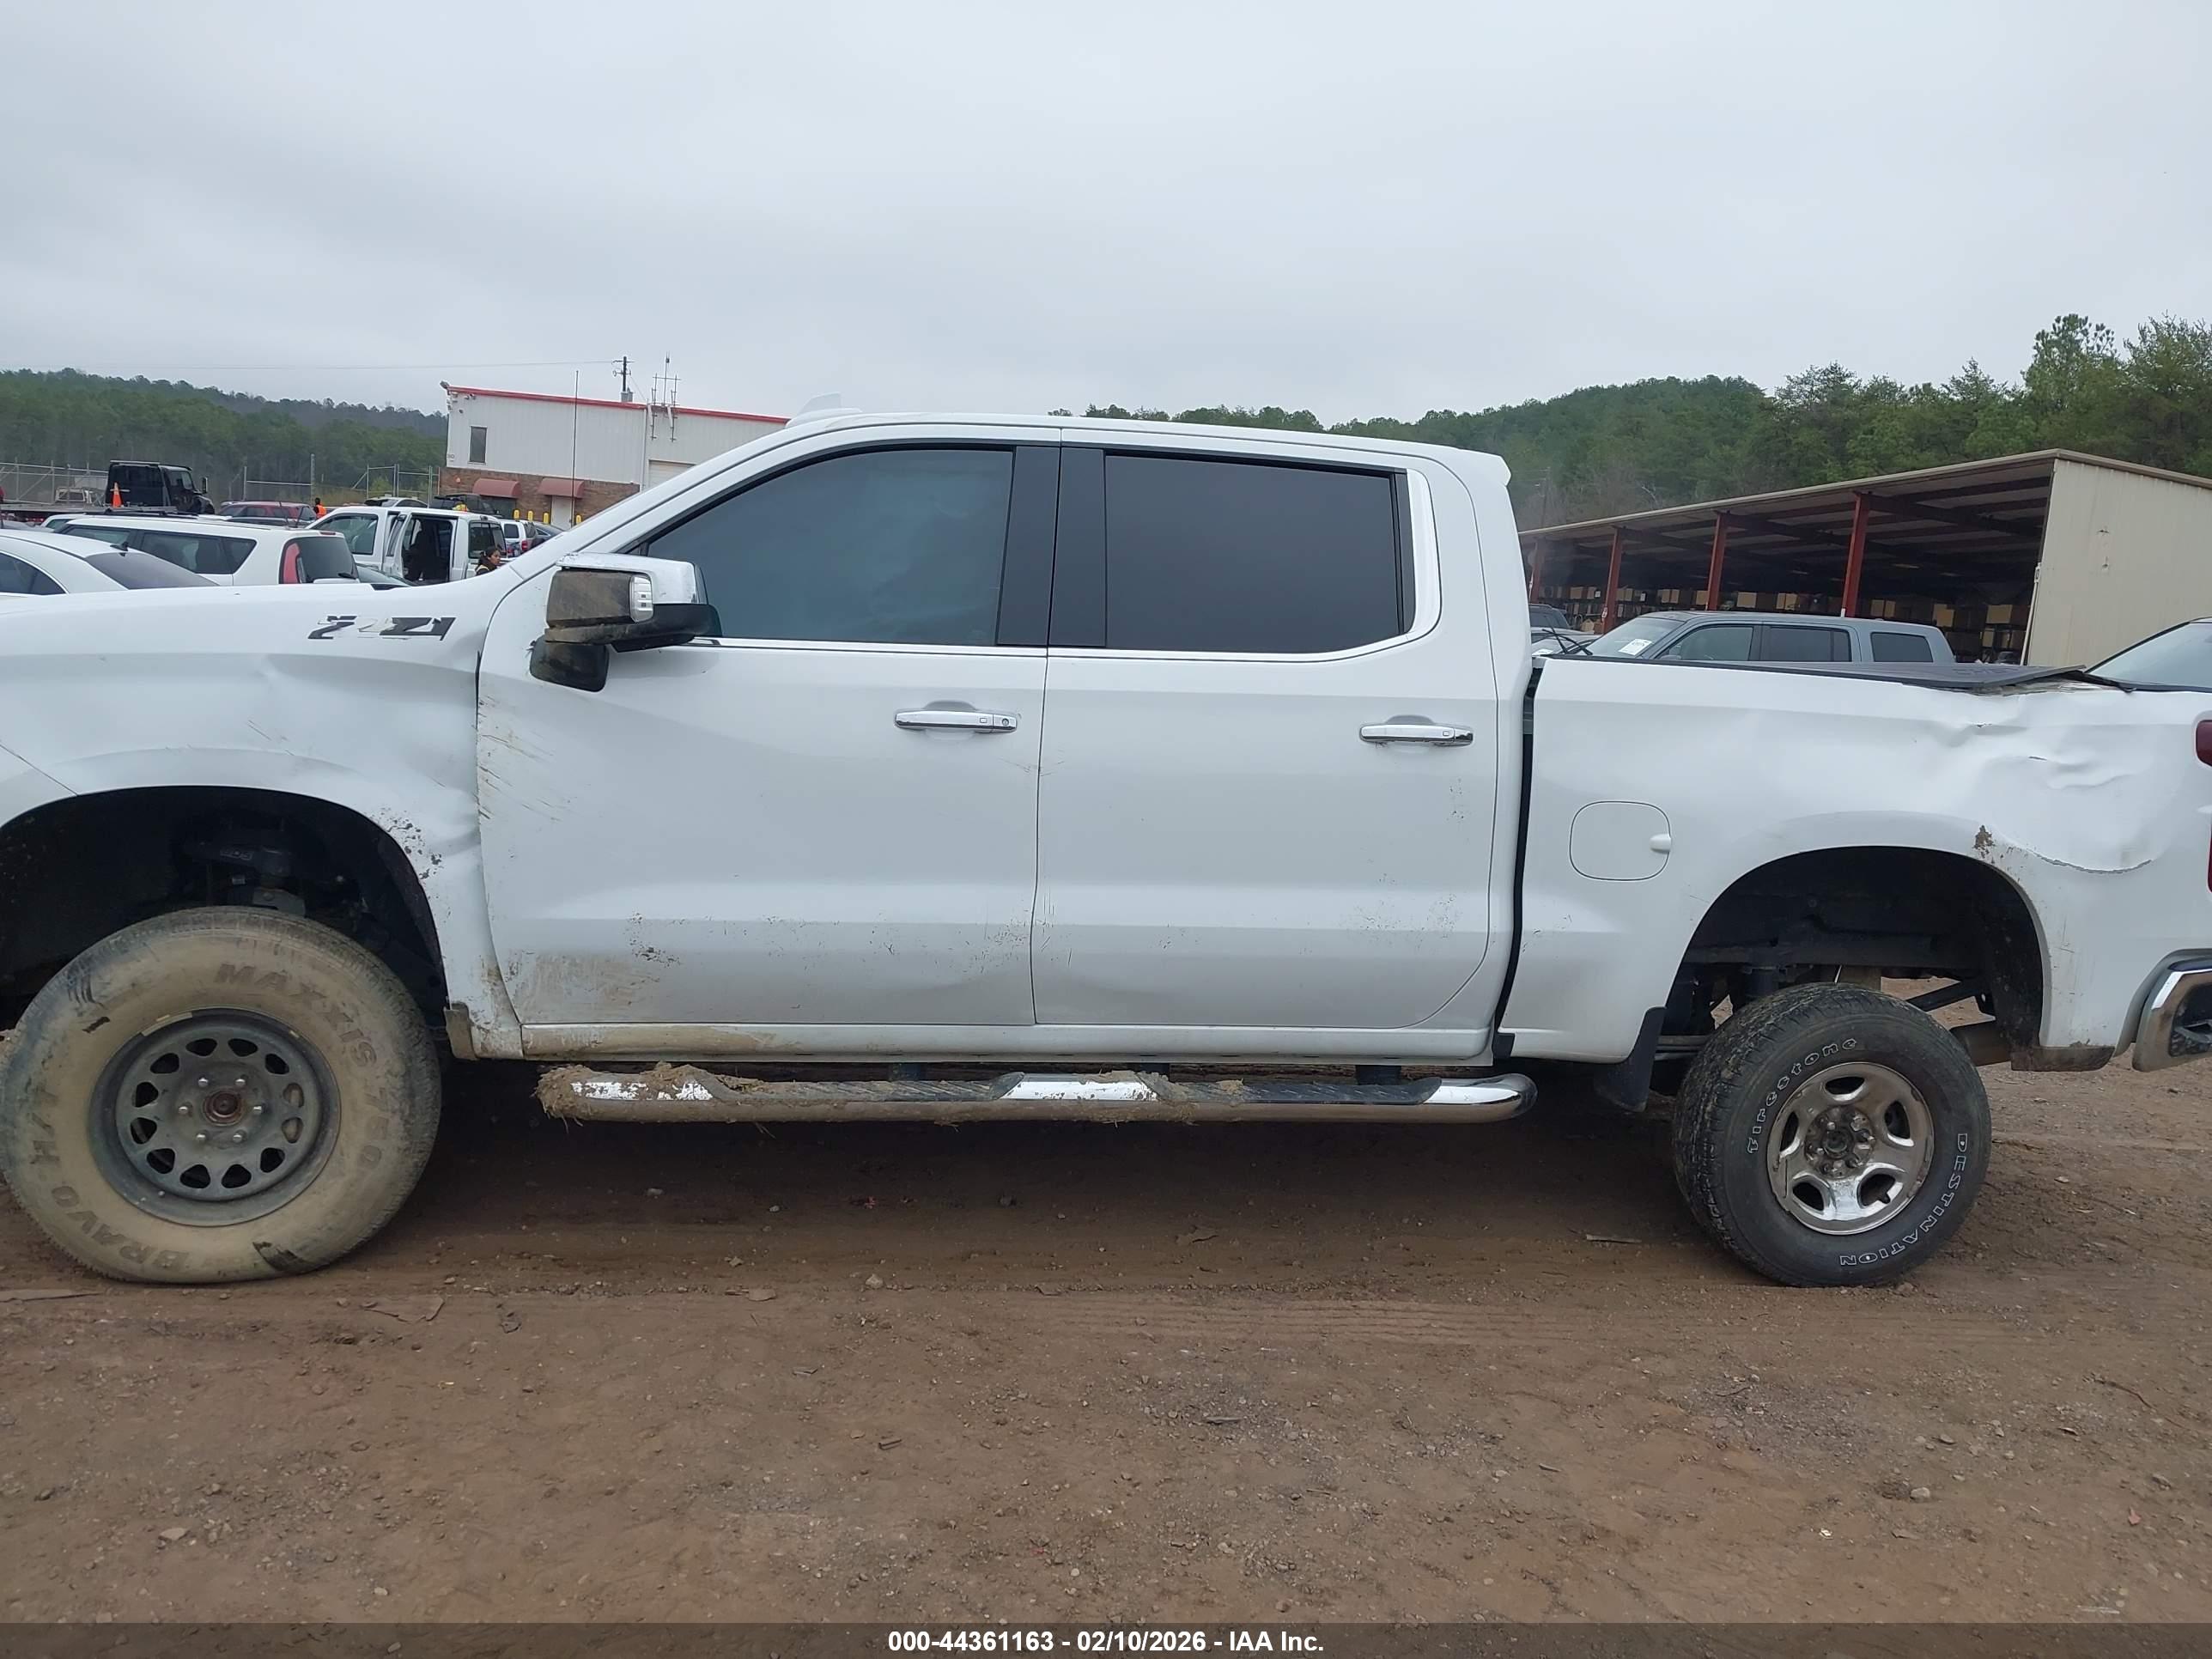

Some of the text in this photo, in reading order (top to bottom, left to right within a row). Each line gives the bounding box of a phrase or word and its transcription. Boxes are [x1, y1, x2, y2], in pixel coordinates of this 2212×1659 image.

[213, 963, 378, 1067] MAXXIS
[50, 1185, 191, 1270] BRAVO
[1839, 1133, 1969, 1267] DESTINATION
